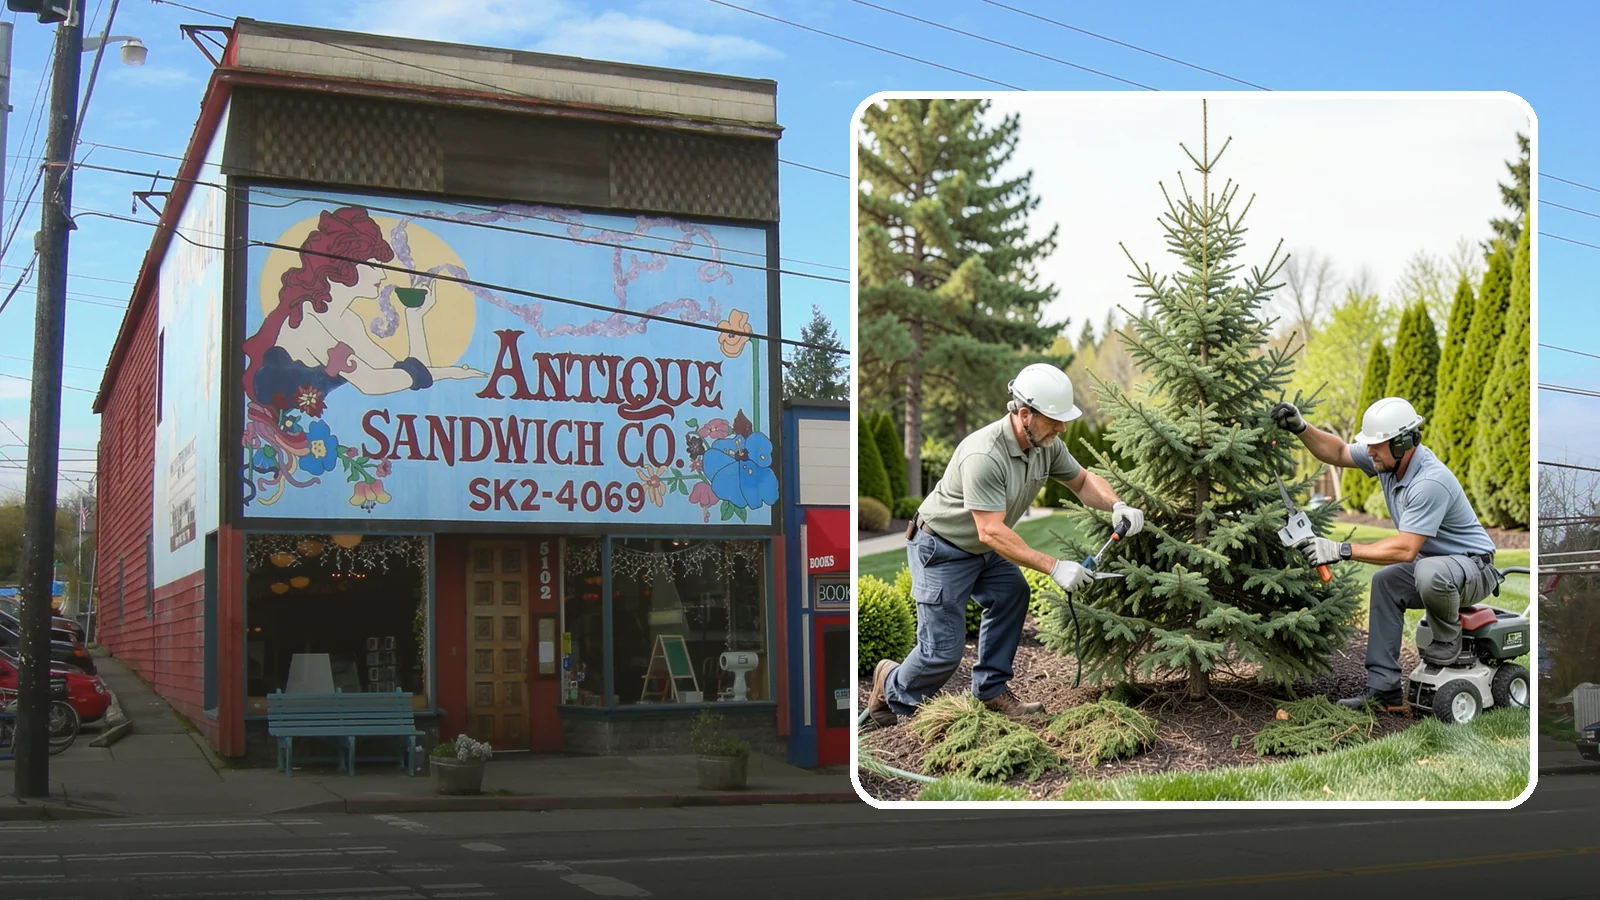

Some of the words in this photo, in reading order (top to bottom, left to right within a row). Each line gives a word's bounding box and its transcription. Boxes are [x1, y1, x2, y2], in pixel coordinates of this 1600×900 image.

[475, 329, 723, 420] ANTIQUE
[361, 408, 604, 467] SANDWICH
[617, 422, 685, 469] CO.
[468, 477, 645, 513] SK2-4069
[540, 541, 552, 599] 5102
[809, 555, 835, 569] BOOKS
